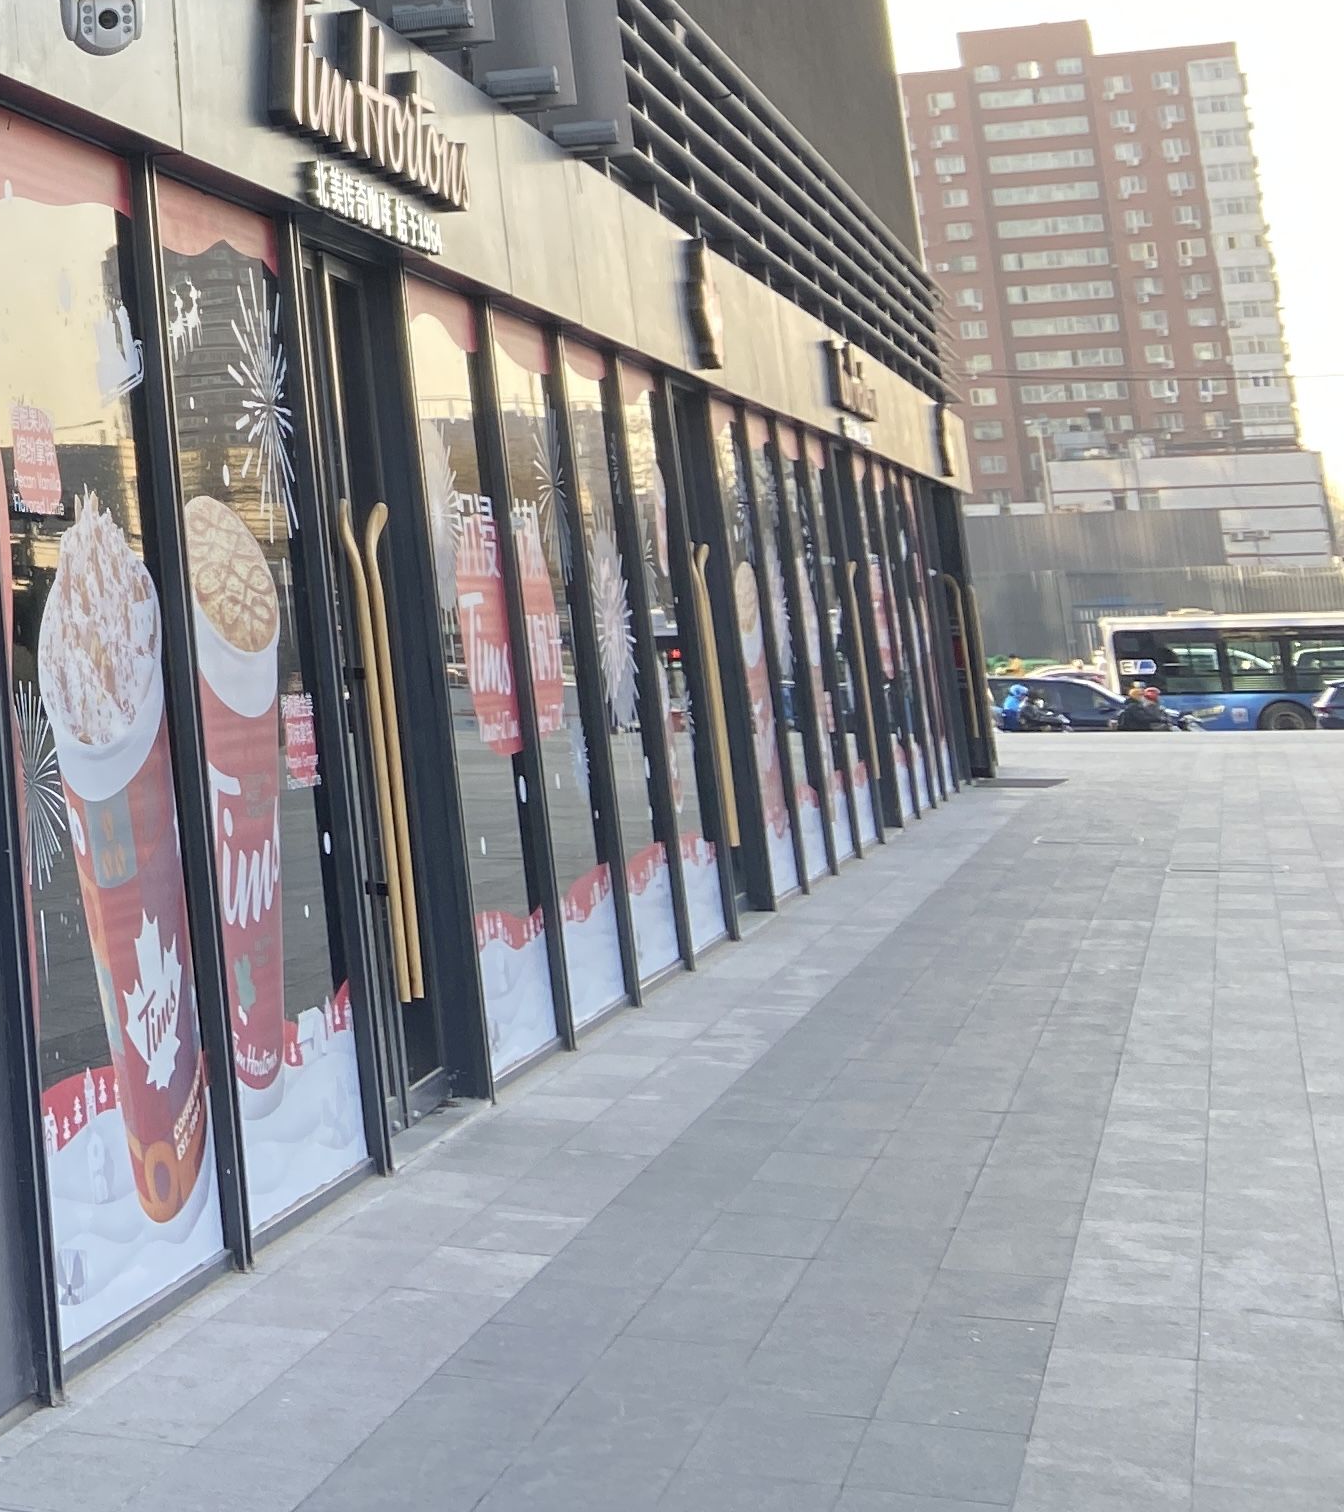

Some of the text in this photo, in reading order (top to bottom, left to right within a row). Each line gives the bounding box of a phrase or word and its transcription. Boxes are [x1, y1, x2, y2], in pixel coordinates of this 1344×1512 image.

[358, 6, 471, 212] Hortons
[314, 159, 392, 237] 北美传奇咖啡
[138, 980, 179, 1062] Tims
